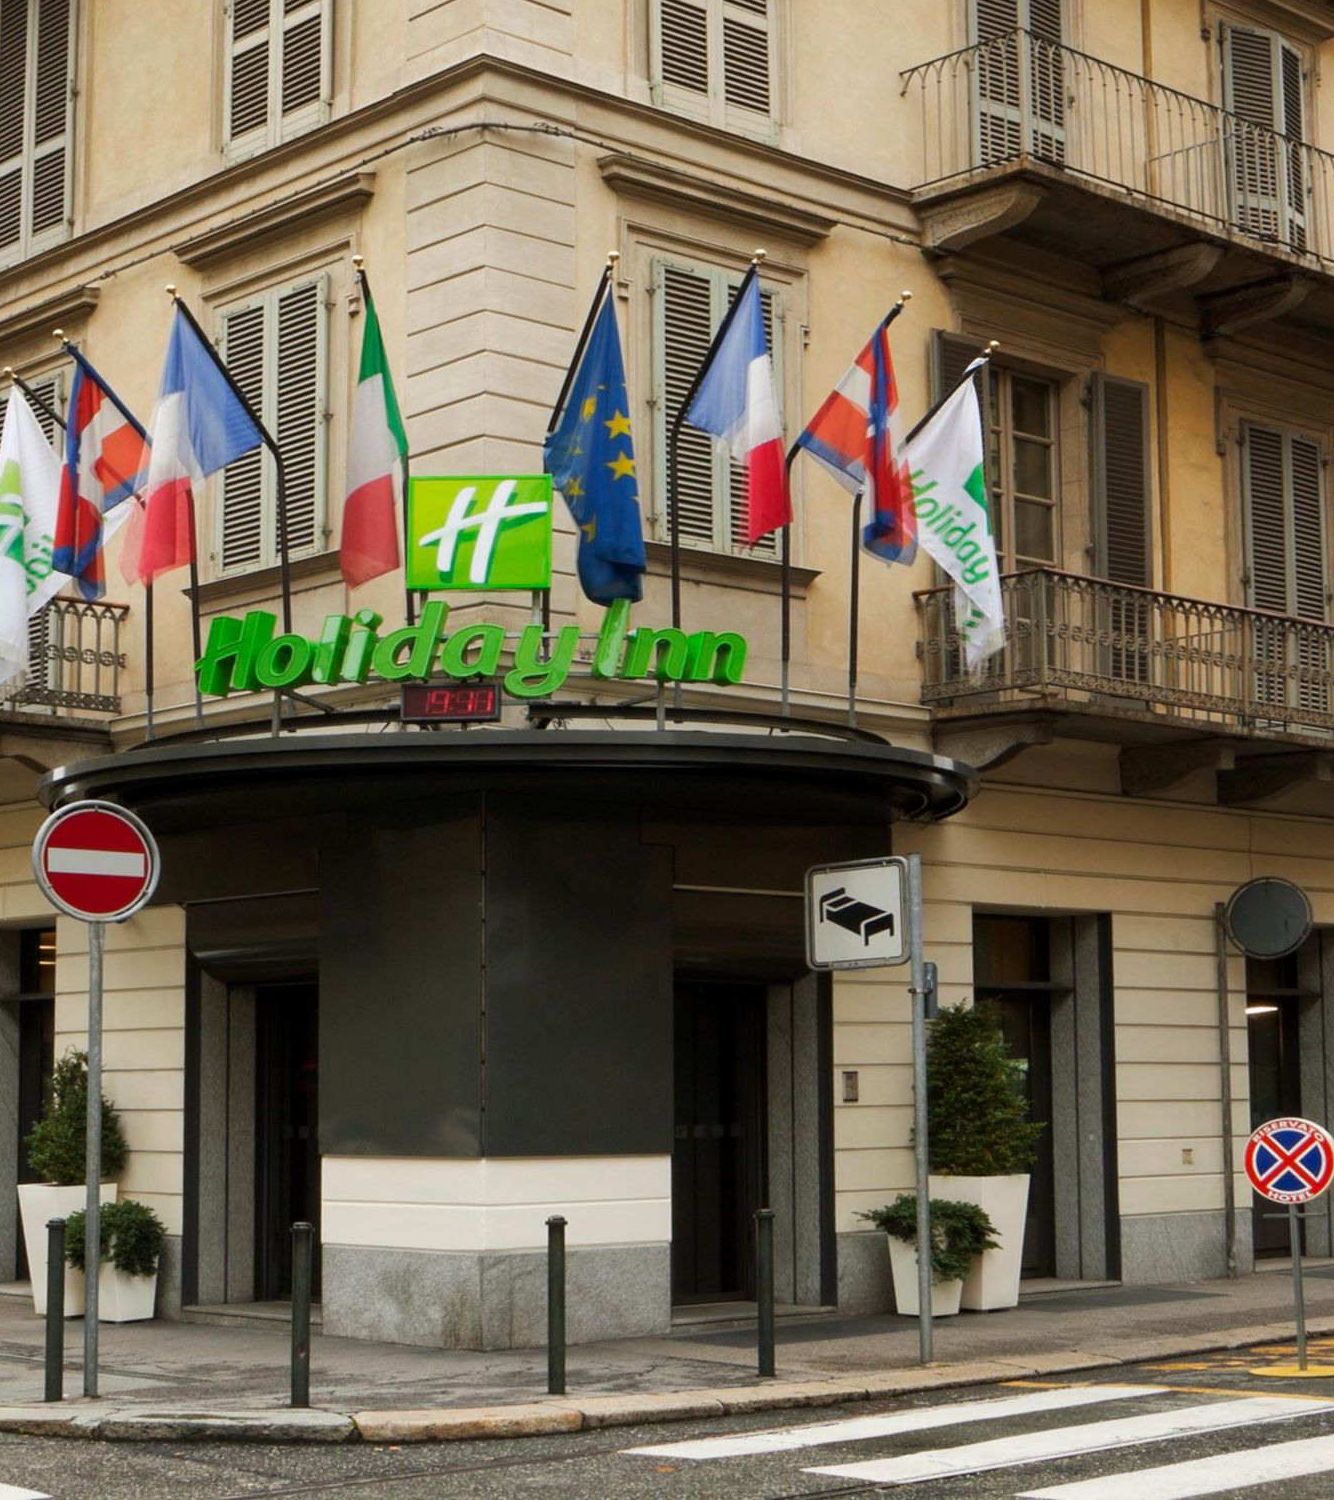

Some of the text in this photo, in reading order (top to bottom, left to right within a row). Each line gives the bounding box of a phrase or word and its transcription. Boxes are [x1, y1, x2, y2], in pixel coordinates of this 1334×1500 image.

[419, 480, 548, 584] H
[195, 598, 749, 698] Holiday Inn
[1252, 1120, 1325, 1143] RISERVATO
[1267, 1190, 1315, 1202] HOTEL
